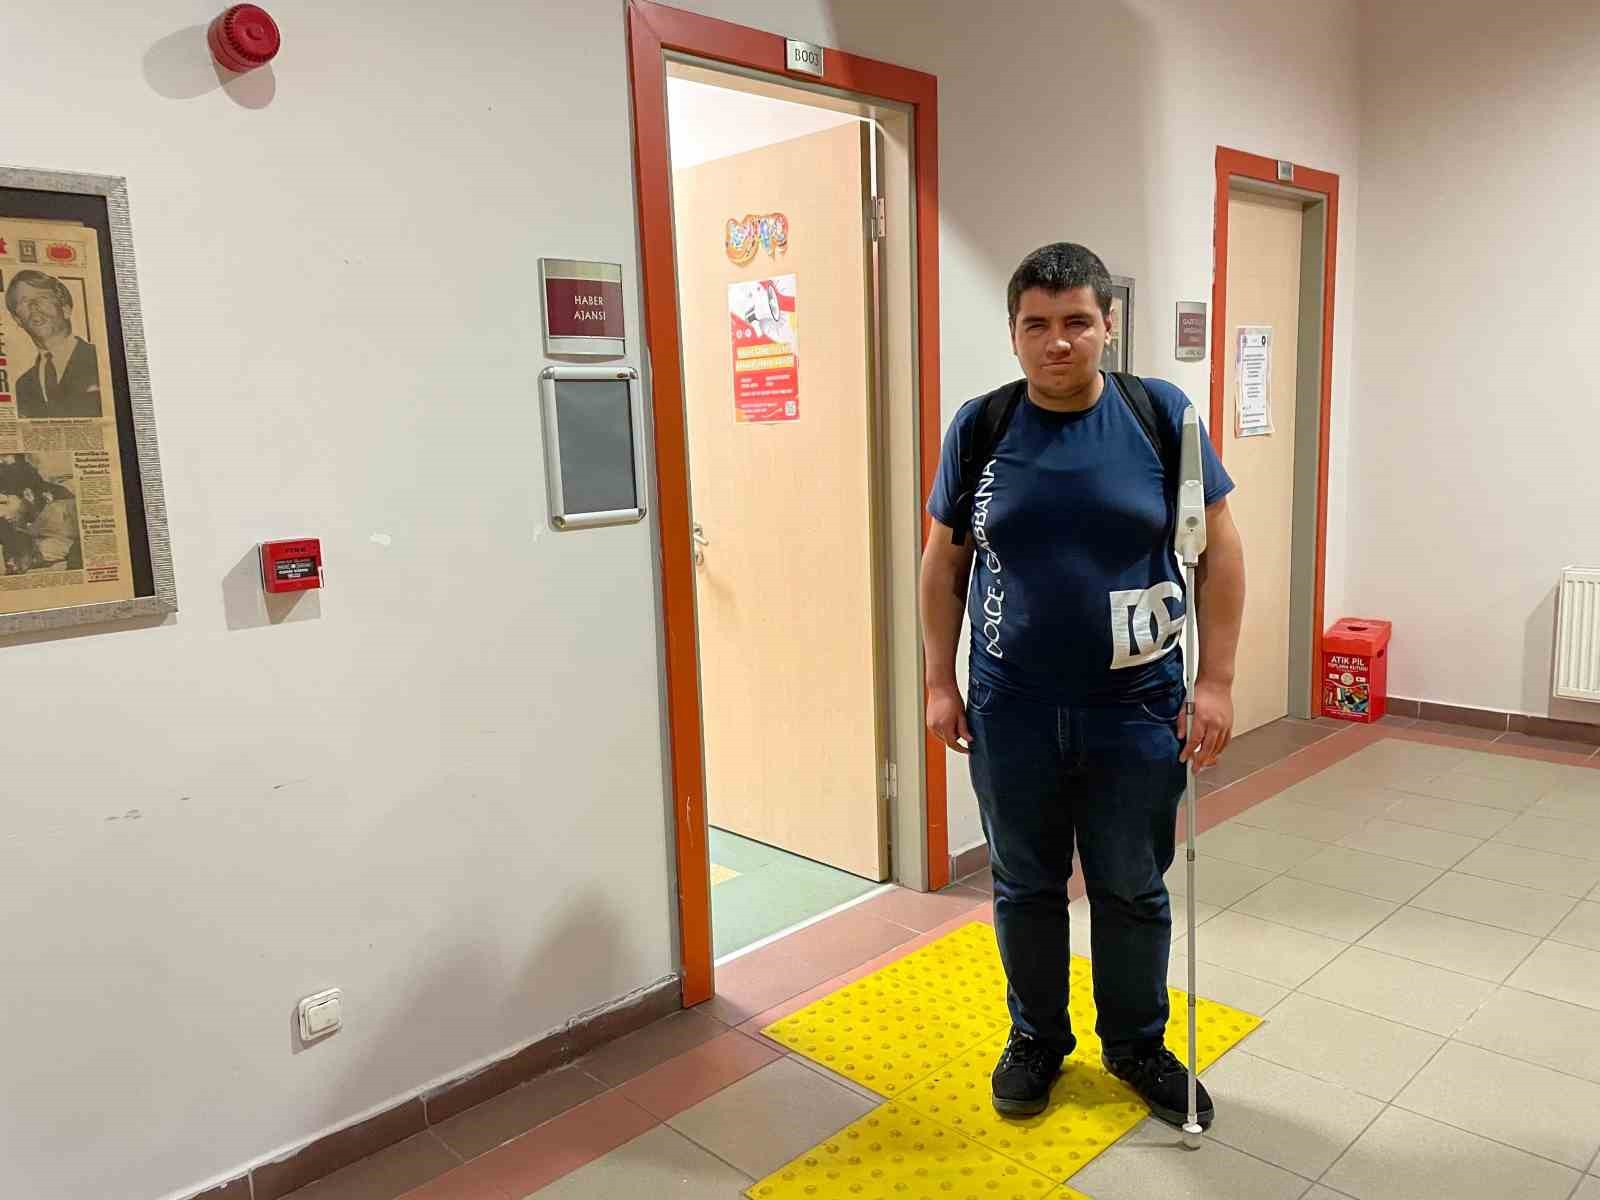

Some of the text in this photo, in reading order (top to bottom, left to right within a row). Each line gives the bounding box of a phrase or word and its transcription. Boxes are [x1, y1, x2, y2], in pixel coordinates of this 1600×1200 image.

[574, 295, 603, 305] HABER
[574, 310, 606, 321] AJANSI
[983, 585, 1005, 659] DOLCE
[1331, 655, 1365, 666] ATIK PİL
